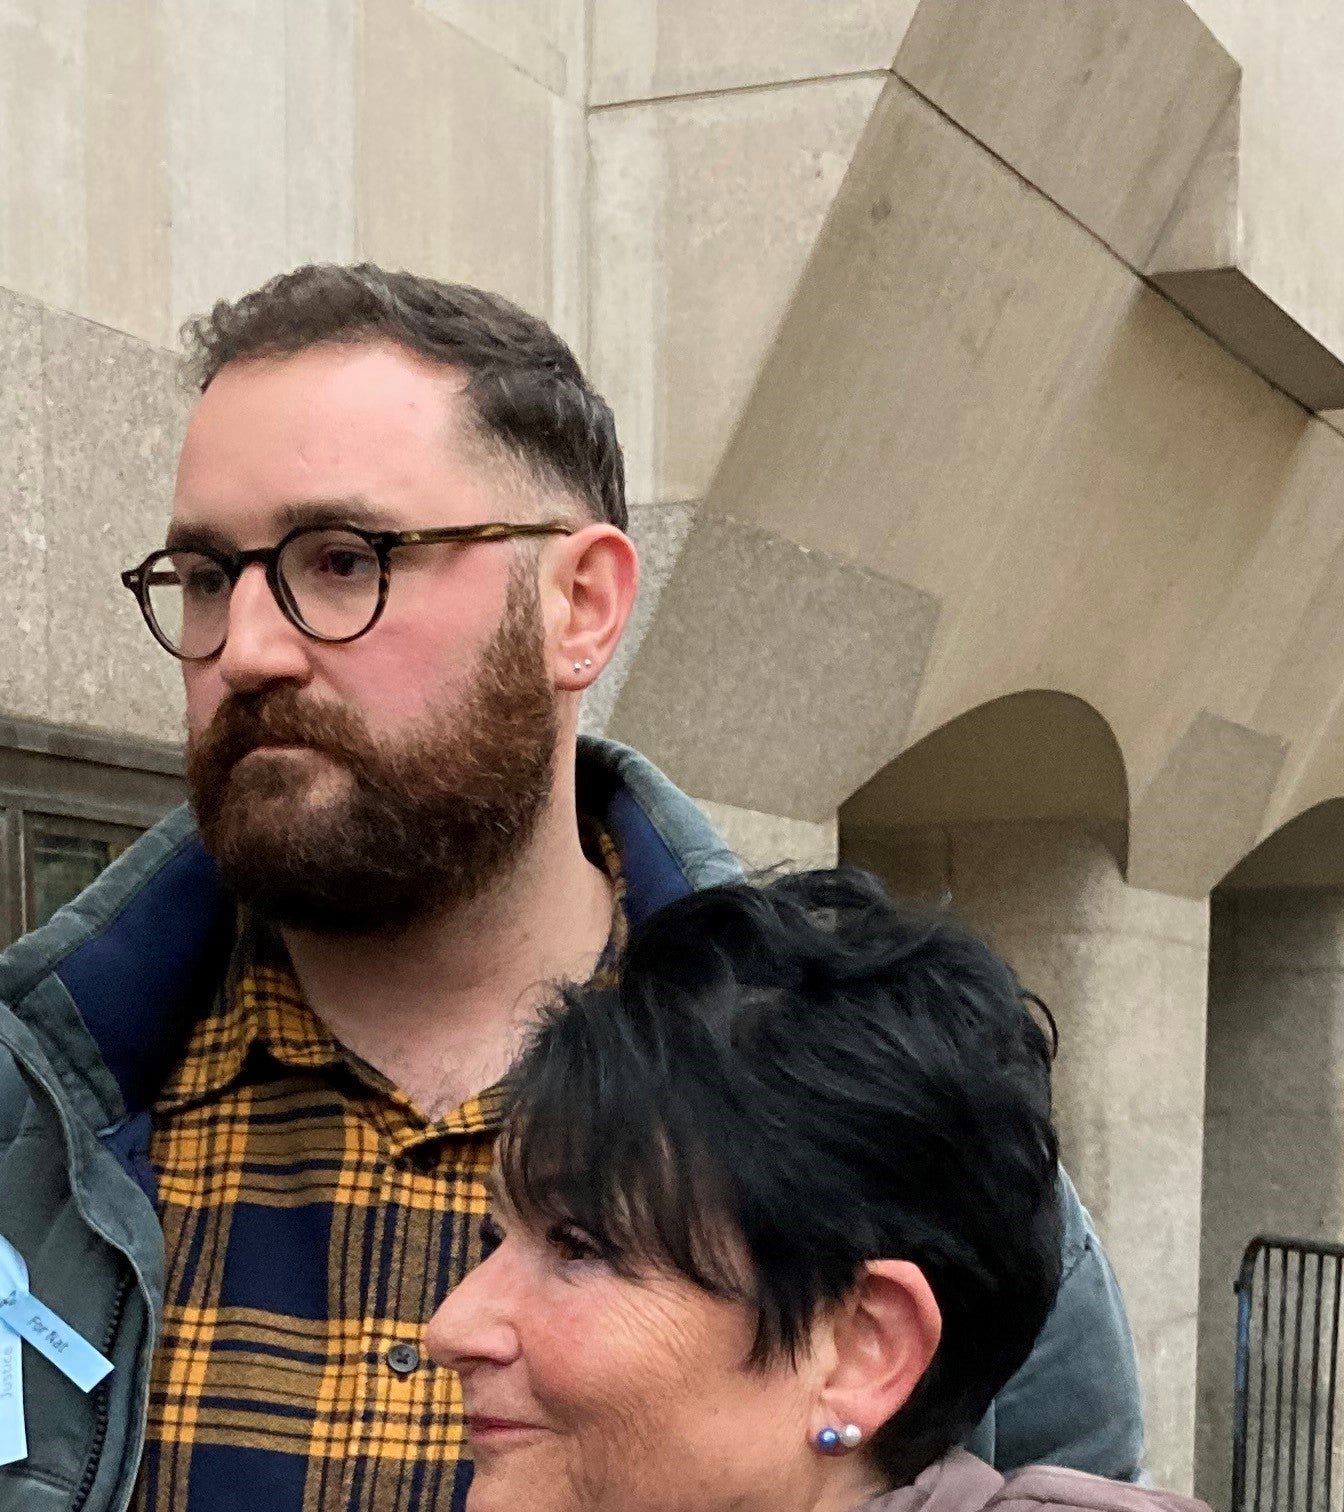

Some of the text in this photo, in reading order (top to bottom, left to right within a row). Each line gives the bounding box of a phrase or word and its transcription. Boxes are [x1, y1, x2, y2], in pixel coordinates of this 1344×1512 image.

[26, 1315, 70, 1354] For Nat
[0, 1345, 15, 1399] Justice
